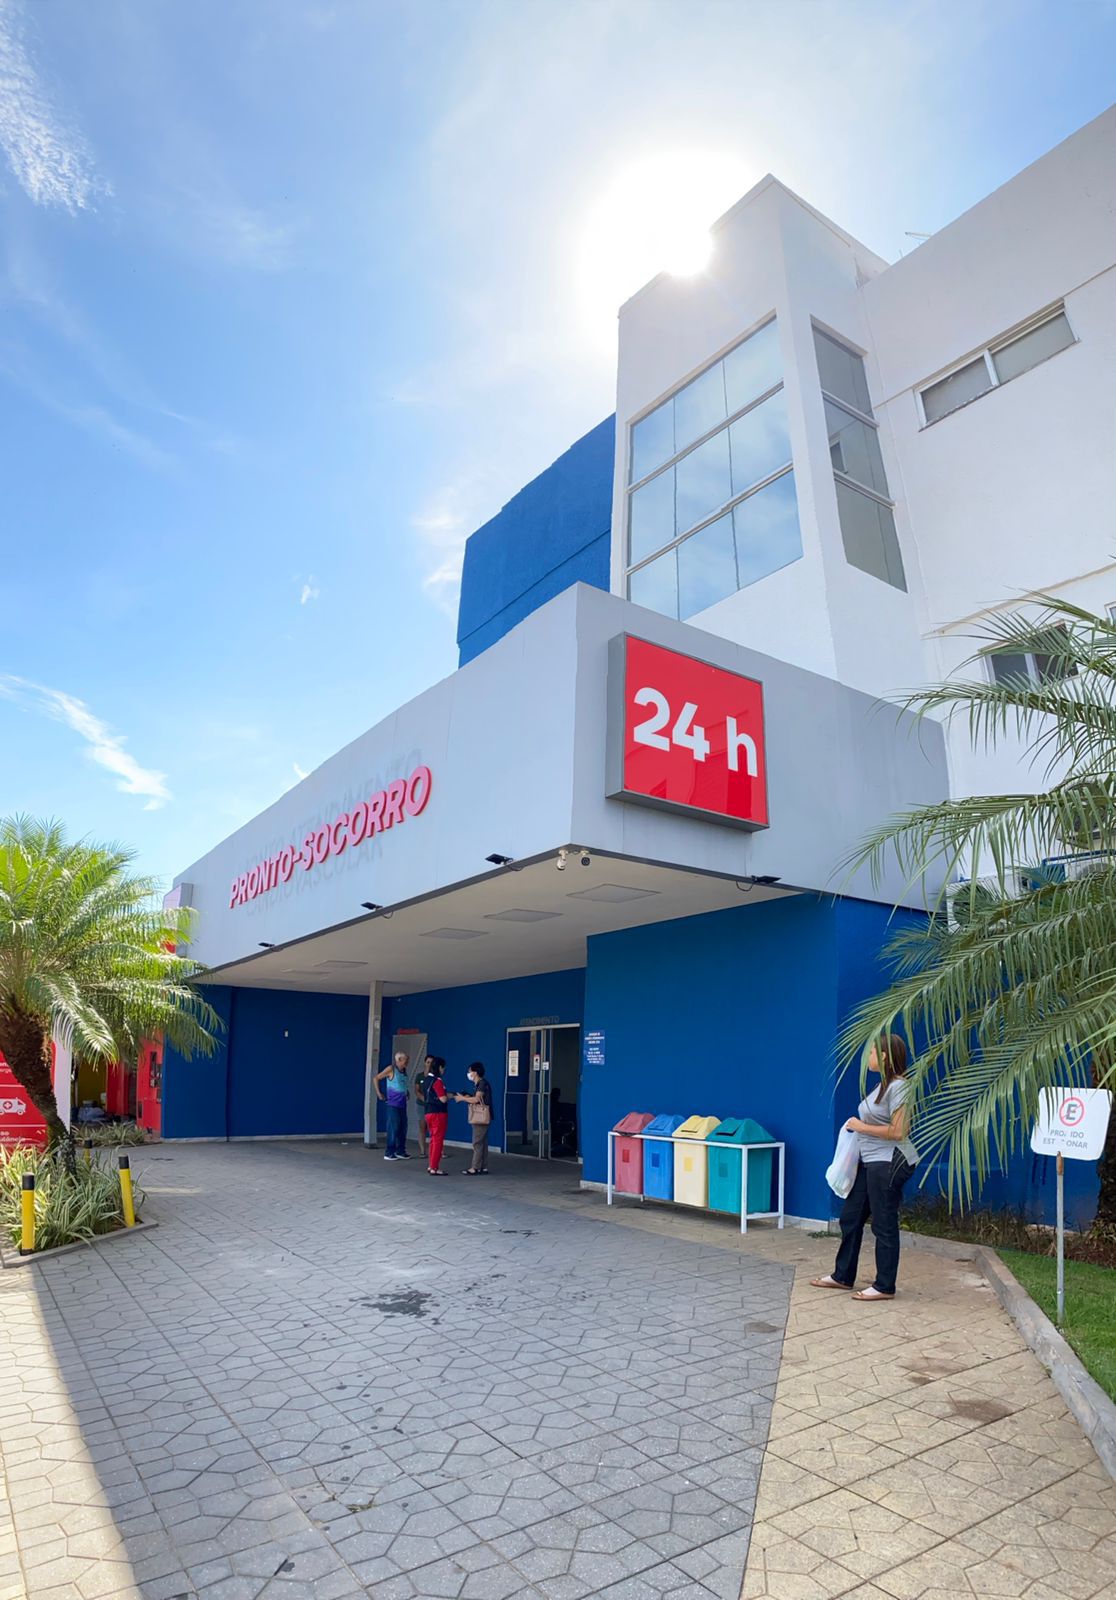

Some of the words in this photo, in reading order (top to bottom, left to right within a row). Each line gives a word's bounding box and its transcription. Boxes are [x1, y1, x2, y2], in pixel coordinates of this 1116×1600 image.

[634, 687, 710, 762] 24
[726, 715, 788, 777] h
[229, 765, 432, 909] PRONTO-SOCORRO
[1043, 1138, 1088, 1149] ESTONAR
[1050, 1129, 1084, 1139] PROIDO
